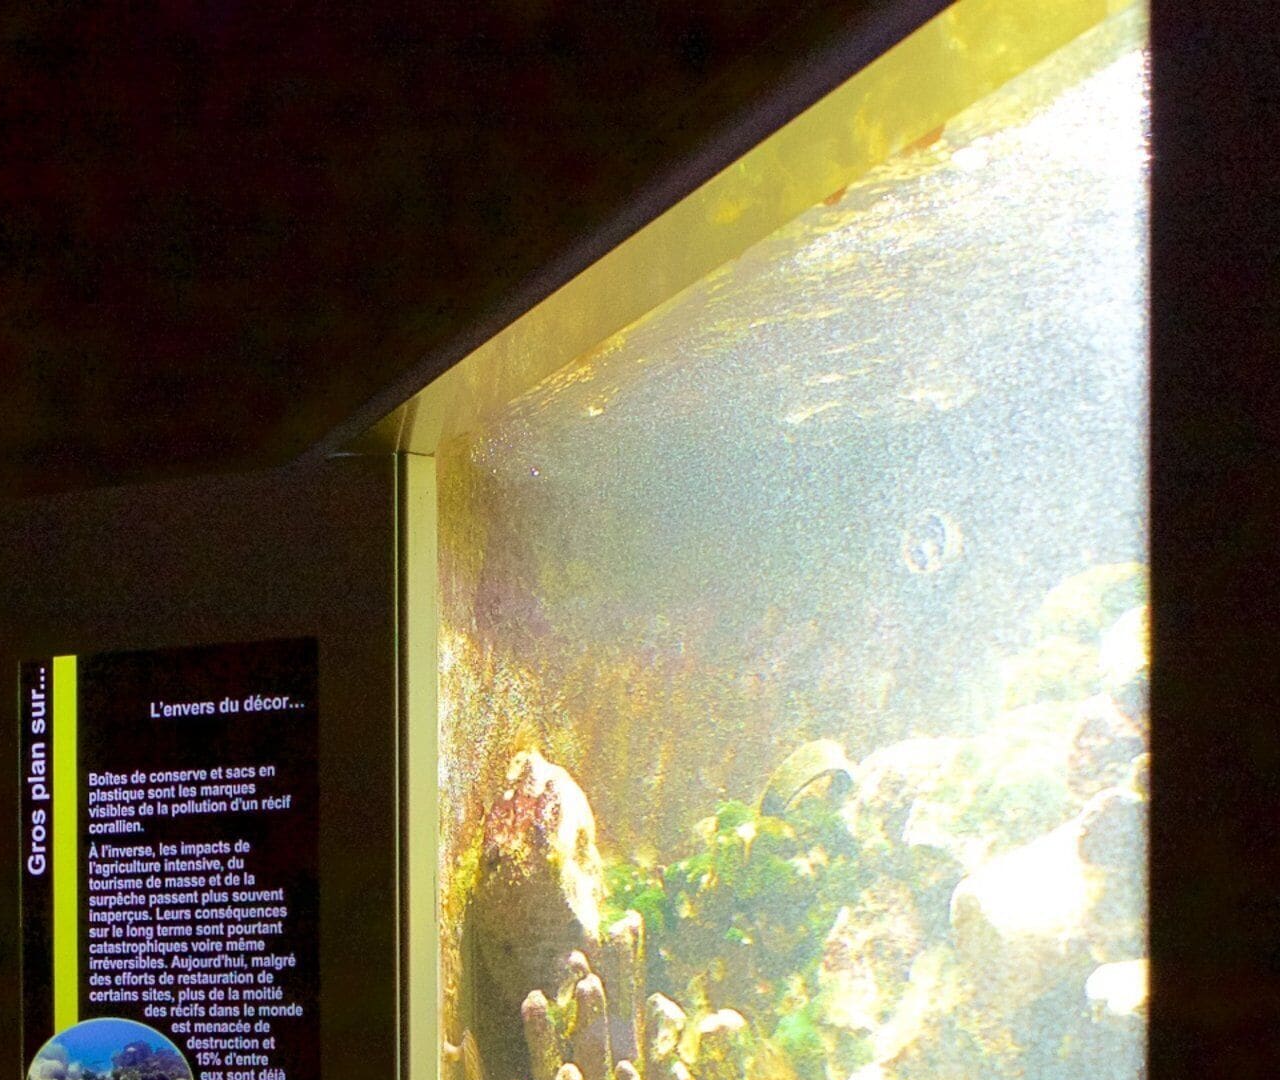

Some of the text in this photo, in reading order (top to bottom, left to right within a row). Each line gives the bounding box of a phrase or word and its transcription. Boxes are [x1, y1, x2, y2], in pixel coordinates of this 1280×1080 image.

[150, 695, 304, 718] L'envers du décor...
[27, 667, 50, 876] Gros plan sur...
[89, 766, 275, 786] Boîtes de conserve et sacs en
[89, 784, 255, 804] plastique sont les marques
[88, 796, 290, 818] visibles de la pollution d'un récif
[89, 819, 144, 834] corallien.
[101, 843, 155, 861] l'inverse,
[160, 842, 177, 855] les
[181, 840, 230, 857] impacts
[235, 839, 250, 852] de
[89, 856, 243, 877] l'agriculture intensive, du
[89, 872, 255, 890] tourisme de masse et de la
[89, 887, 283, 909] surpêche passent plus souvent
[89, 904, 287, 925] inaperçus. Leurs conséquences
[89, 921, 282, 939] sur le long terme sont pourtant
[89, 937, 264, 956] catastrophiques voire même
[89, 954, 296, 971] irréversibles. Aujourd'hui, malgré
[90, 971, 273, 985] des efforts de restauration de
[89, 987, 283, 1004] certains sites, plus de la moitié
[144, 1003, 303, 1017] des récifs dans le monde
[171, 1020, 270, 1033] est menacée de
[187, 1036, 275, 1049] destruction et
[196, 1053, 268, 1065] 15% d'entre
